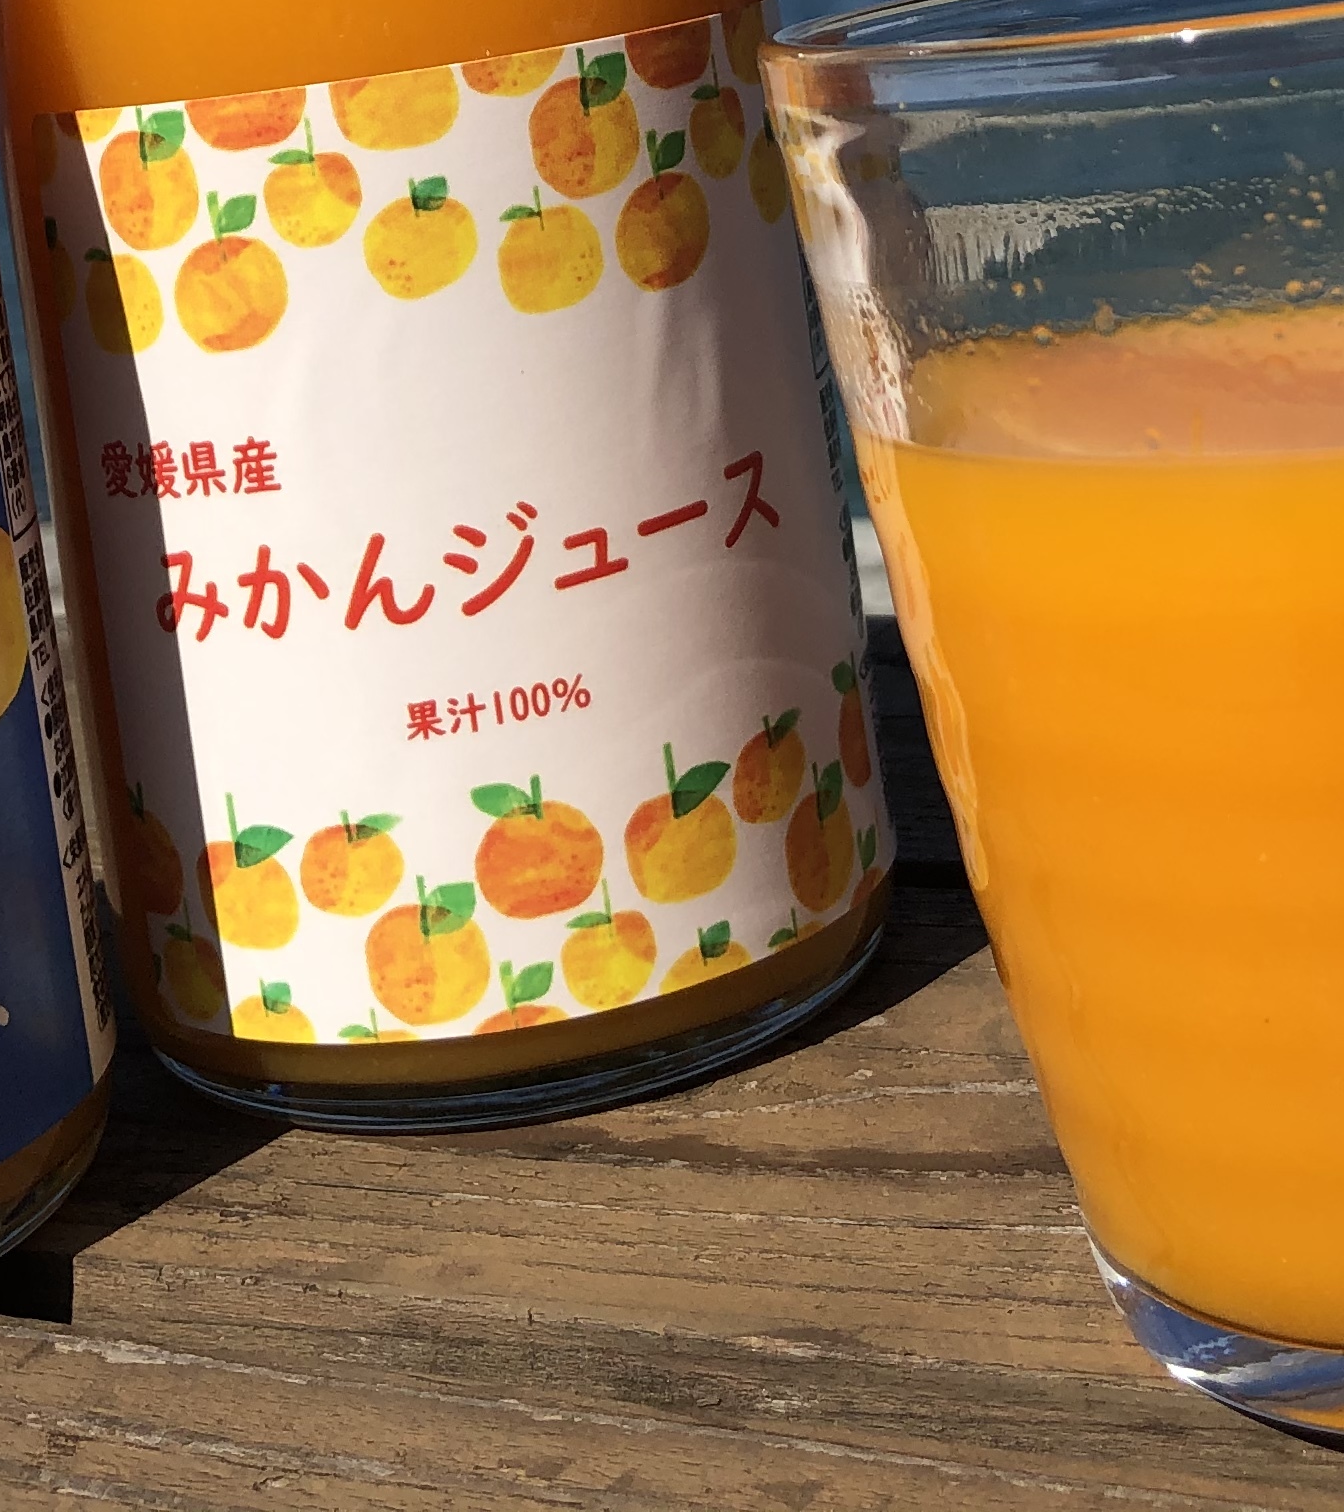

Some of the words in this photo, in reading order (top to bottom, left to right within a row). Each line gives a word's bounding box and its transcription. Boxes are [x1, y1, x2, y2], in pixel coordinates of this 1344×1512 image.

[100, 435, 281, 499] 愛媛県産
[157, 450, 781, 642] みかんジュース
[406, 673, 592, 740] 果汁100%
